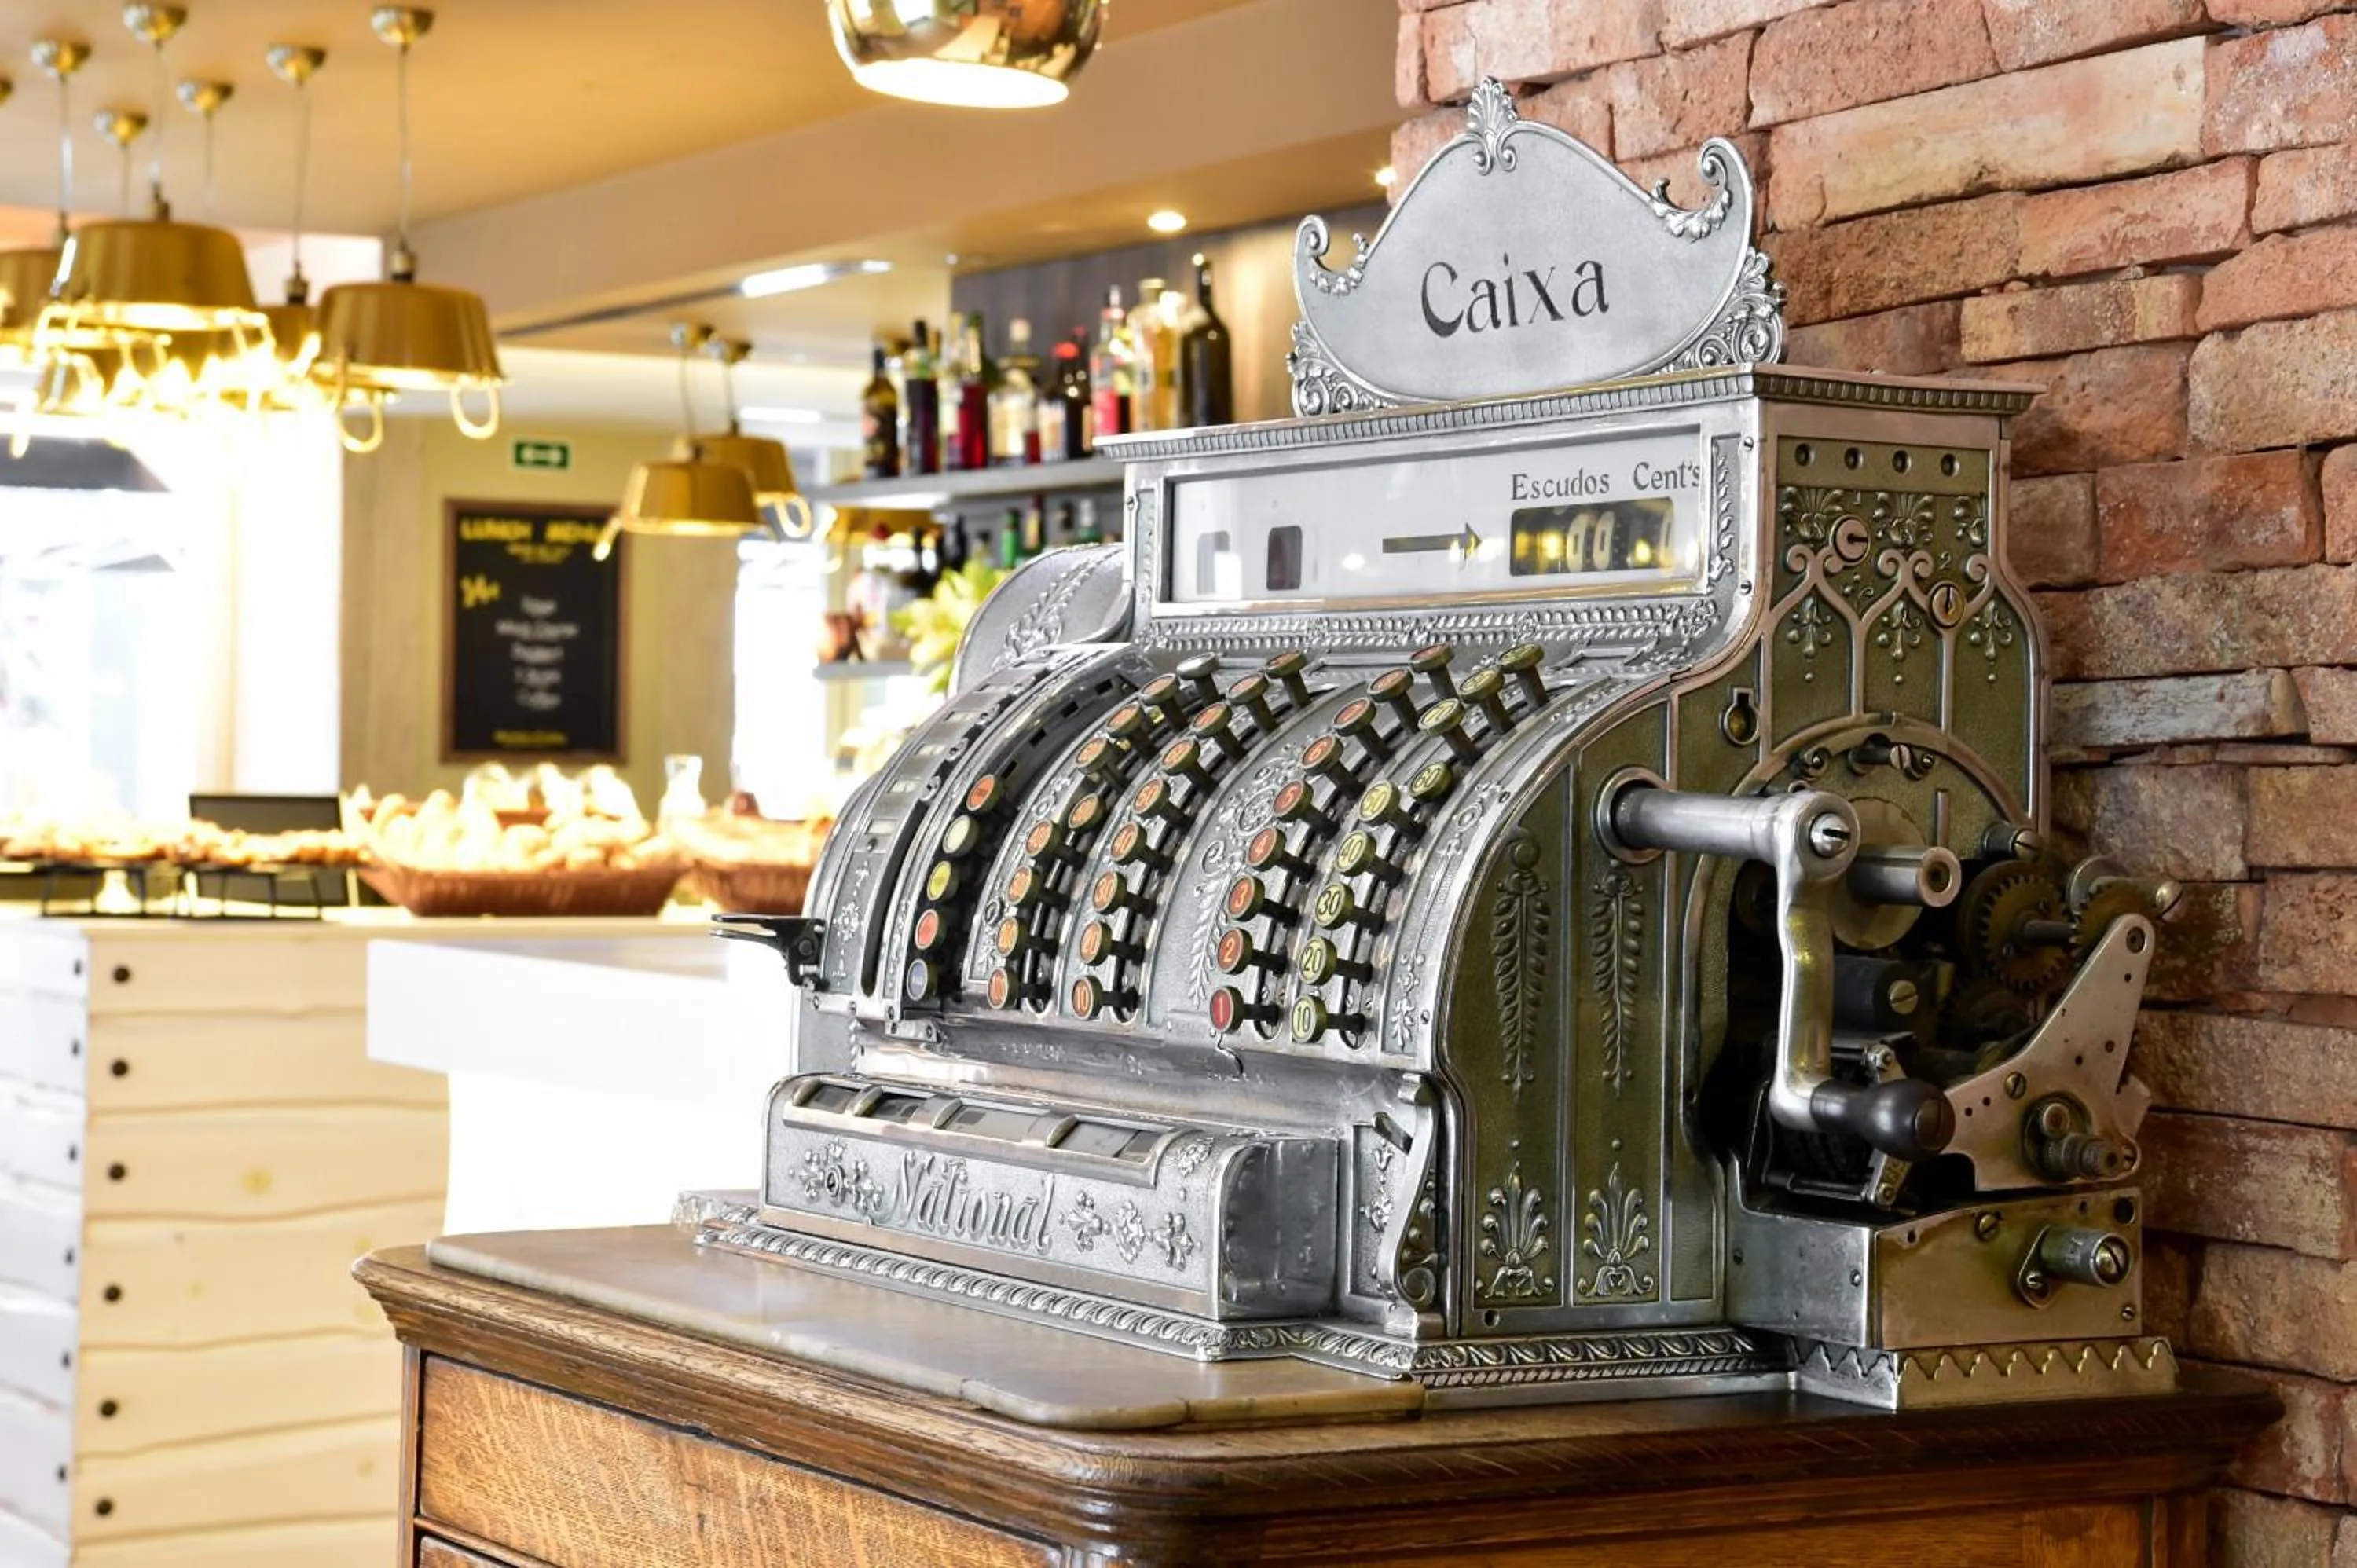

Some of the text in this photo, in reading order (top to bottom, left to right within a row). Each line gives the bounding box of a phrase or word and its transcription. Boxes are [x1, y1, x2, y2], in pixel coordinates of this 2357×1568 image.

[1420, 253, 1610, 337] Caixa
[1512, 460, 1700, 500] Escudos Cent's
[1255, 836, 1267, 857] 4
[1339, 838, 1364, 863] 40
[1236, 883, 1249, 908] 3
[1317, 890, 1341, 917] 30
[1222, 938, 1234, 963] 2
[1302, 947, 1323, 970] 20
[1077, 986, 1087, 1009] 10
[1219, 998, 1223, 1024] 1
[1296, 1006, 1311, 1030] 10
[871, 1149, 1055, 1255] National
